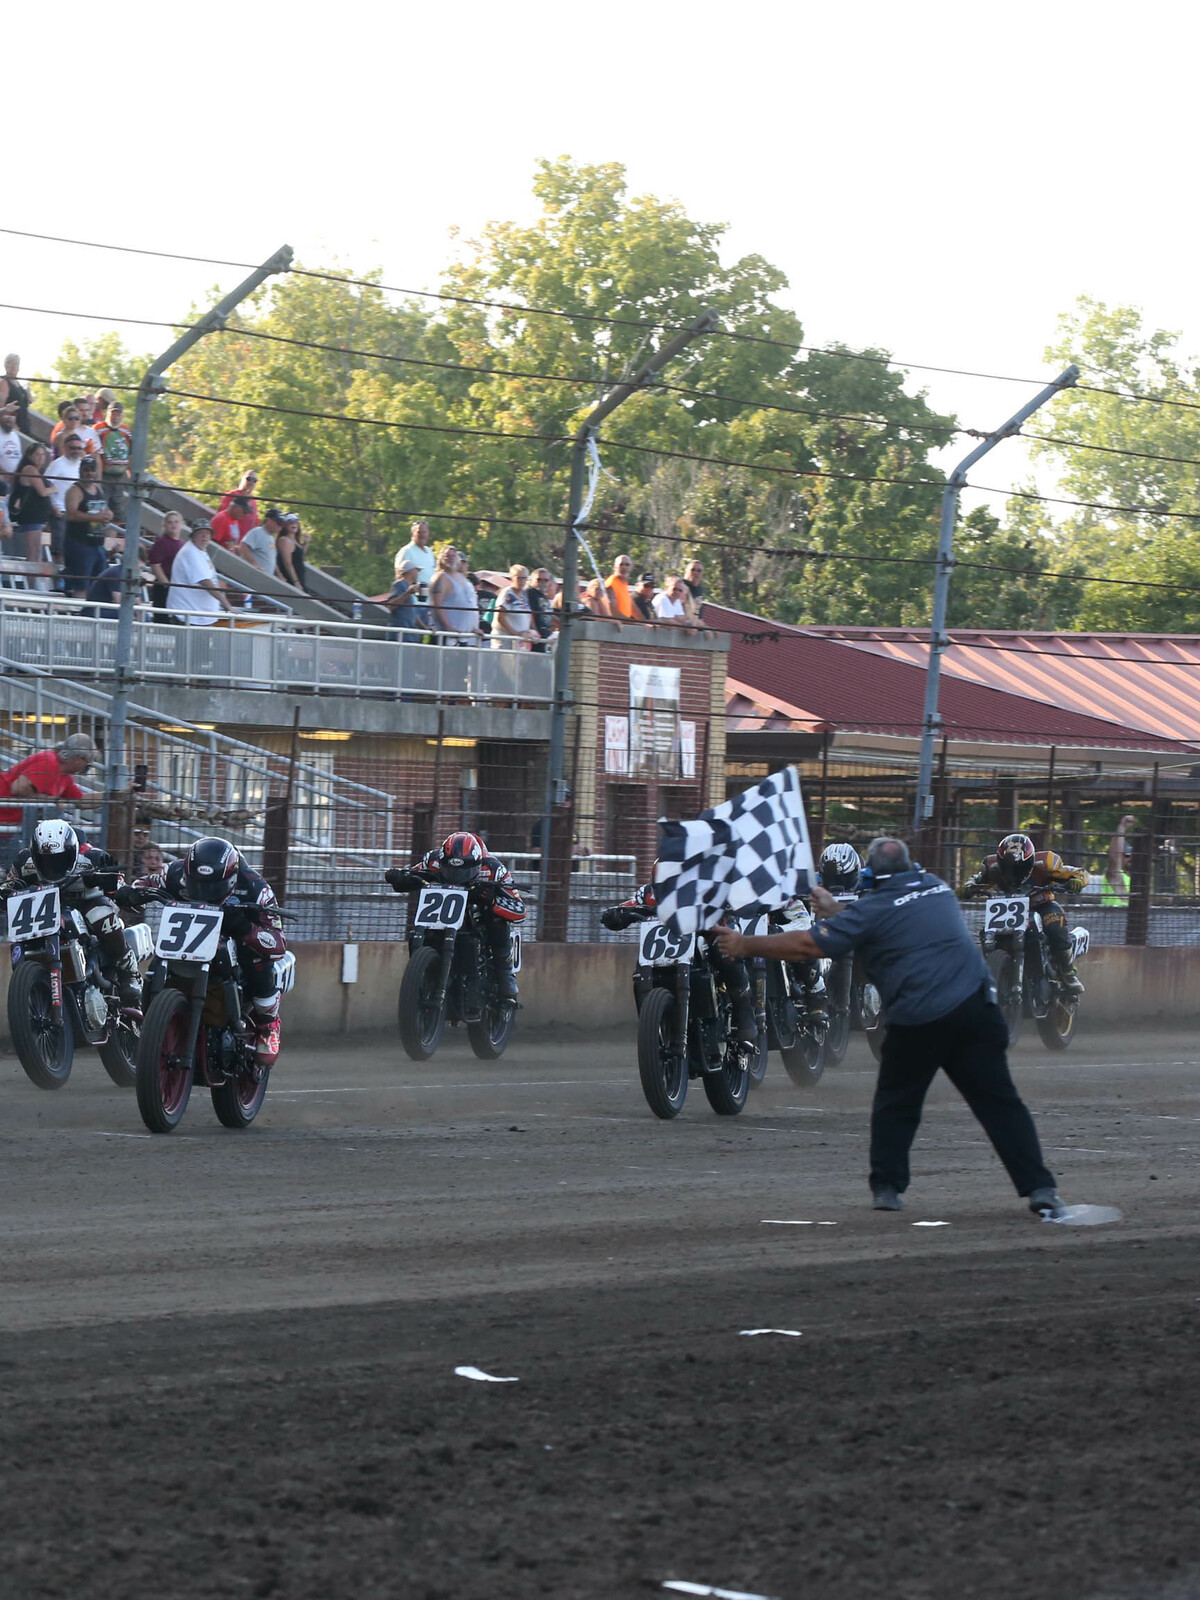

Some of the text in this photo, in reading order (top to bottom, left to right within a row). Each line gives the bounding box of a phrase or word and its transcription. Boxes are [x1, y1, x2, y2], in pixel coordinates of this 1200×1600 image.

[11, 892, 57, 935] 44
[101, 916, 125, 934] 44
[417, 892, 464, 924] 20
[988, 902, 1025, 928] 23
[160, 912, 220, 953] 37
[642, 924, 692, 961] 69
